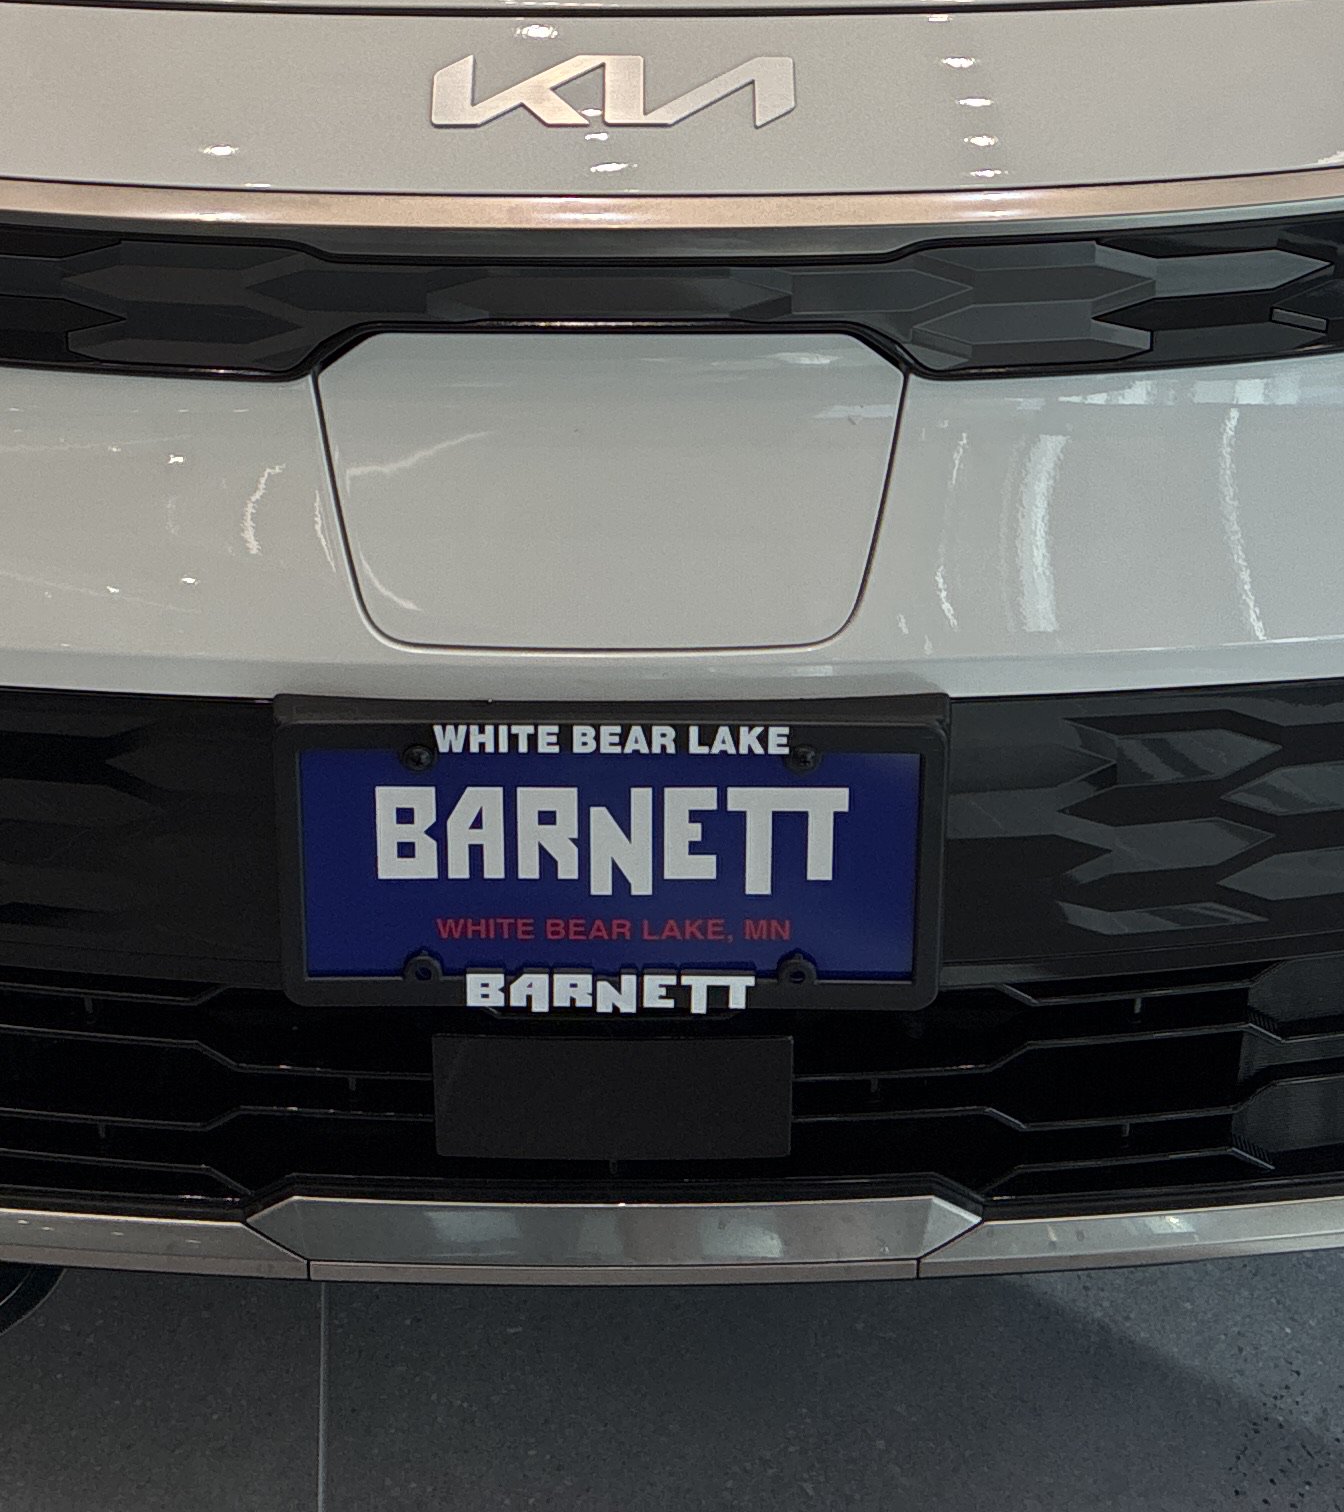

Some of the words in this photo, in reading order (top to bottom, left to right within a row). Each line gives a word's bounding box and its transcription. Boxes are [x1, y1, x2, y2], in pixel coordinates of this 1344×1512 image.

[431, 54, 796, 129] KIA
[433, 724, 560, 755] WHITE
[572, 725, 677, 755] BEAR
[689, 725, 790, 755] LAKE
[374, 785, 850, 895] BARNETT
[436, 918, 535, 940] WHITE
[546, 918, 631, 941] BEAR
[641, 919, 733, 943] LAKE,
[744, 919, 791, 941] MN
[466, 973, 755, 1014] BARNETT
